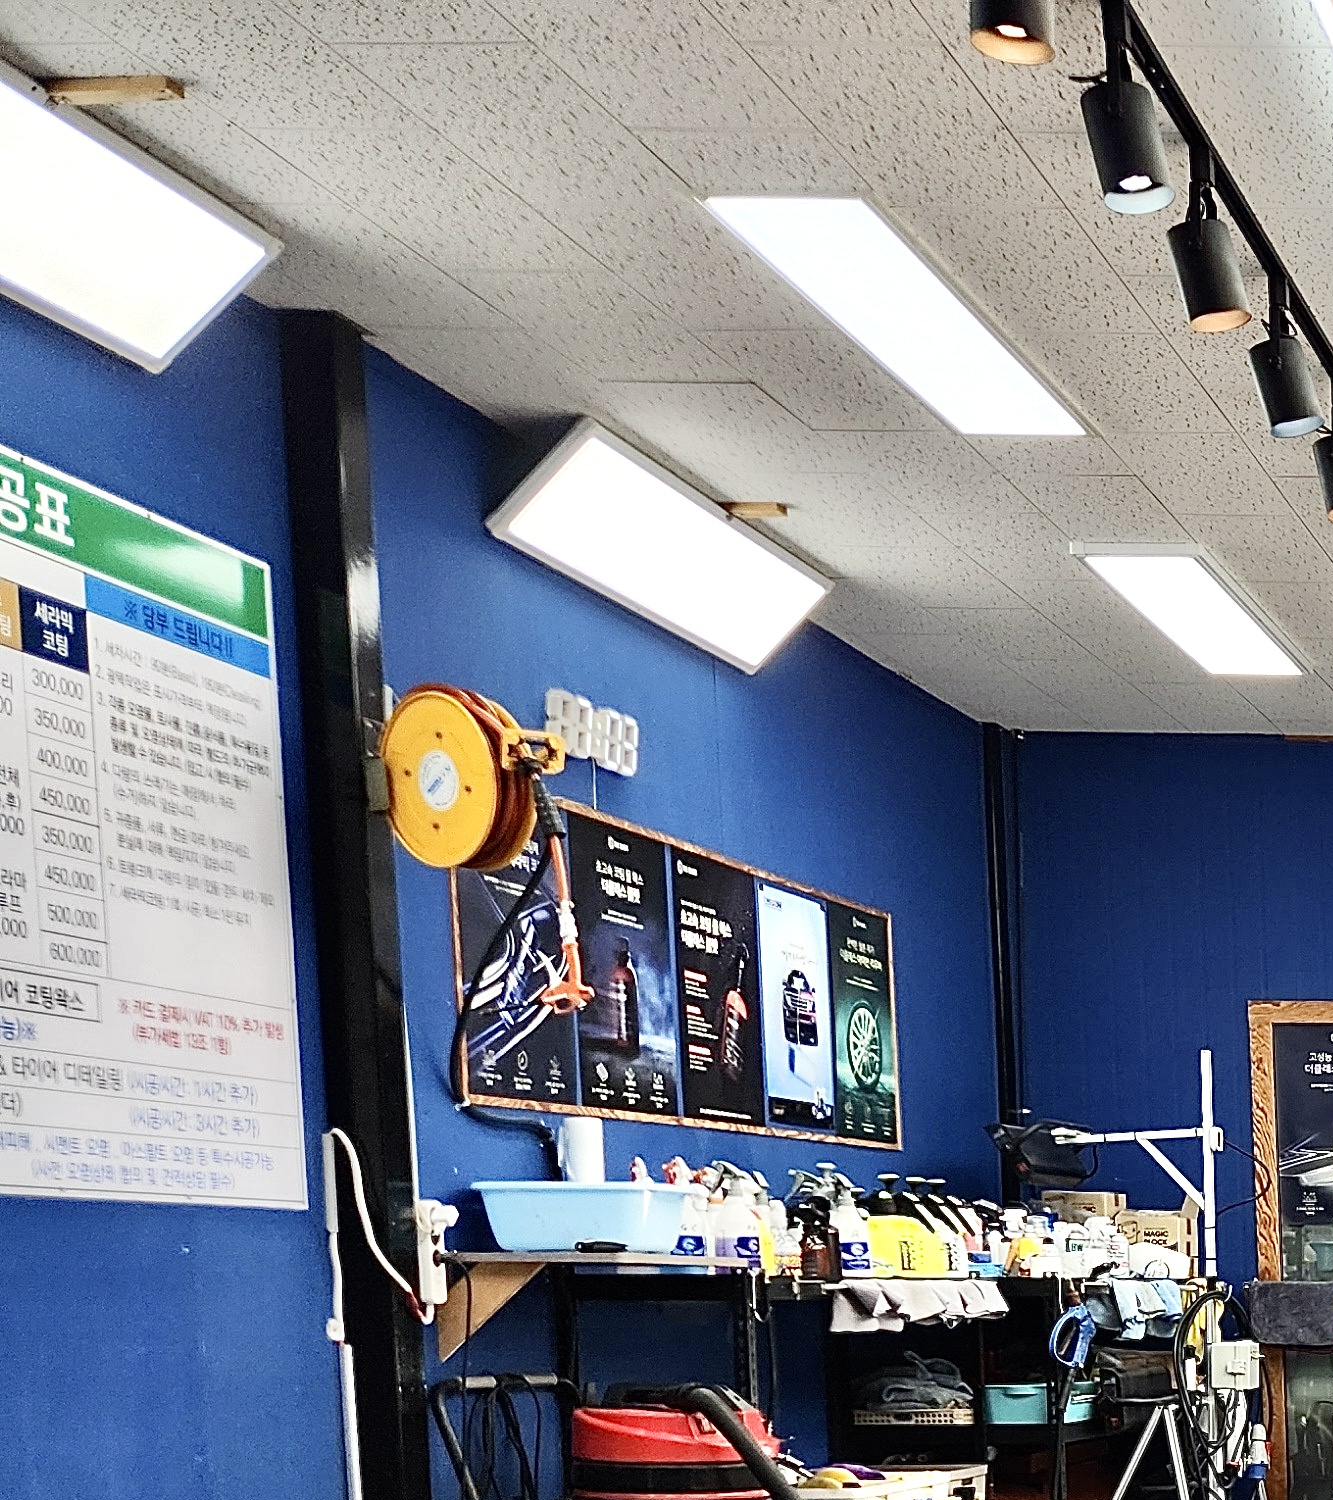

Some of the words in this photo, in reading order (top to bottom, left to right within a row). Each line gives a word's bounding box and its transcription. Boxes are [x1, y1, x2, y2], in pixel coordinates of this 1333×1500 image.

[34, 600, 74, 634] 세라믹
[141, 605, 169, 635] 당부
[43, 629, 69, 658] 코팅
[31, 668, 83, 700] 300,000
[34, 708, 86, 739] 350,000
[37, 746, 88, 778] 400,000
[39, 786, 90, 816] 450,000
[42, 825, 93, 853] 350,000
[44, 865, 96, 892] 450,000
[48, 904, 98, 930] 500,000
[50, 942, 101, 968] 600,000
[25, 983, 85, 1012] 코팅왁스
[11, 1056, 58, 1083] 타이어
[1309, 1052, 1332, 1062] 고성능
